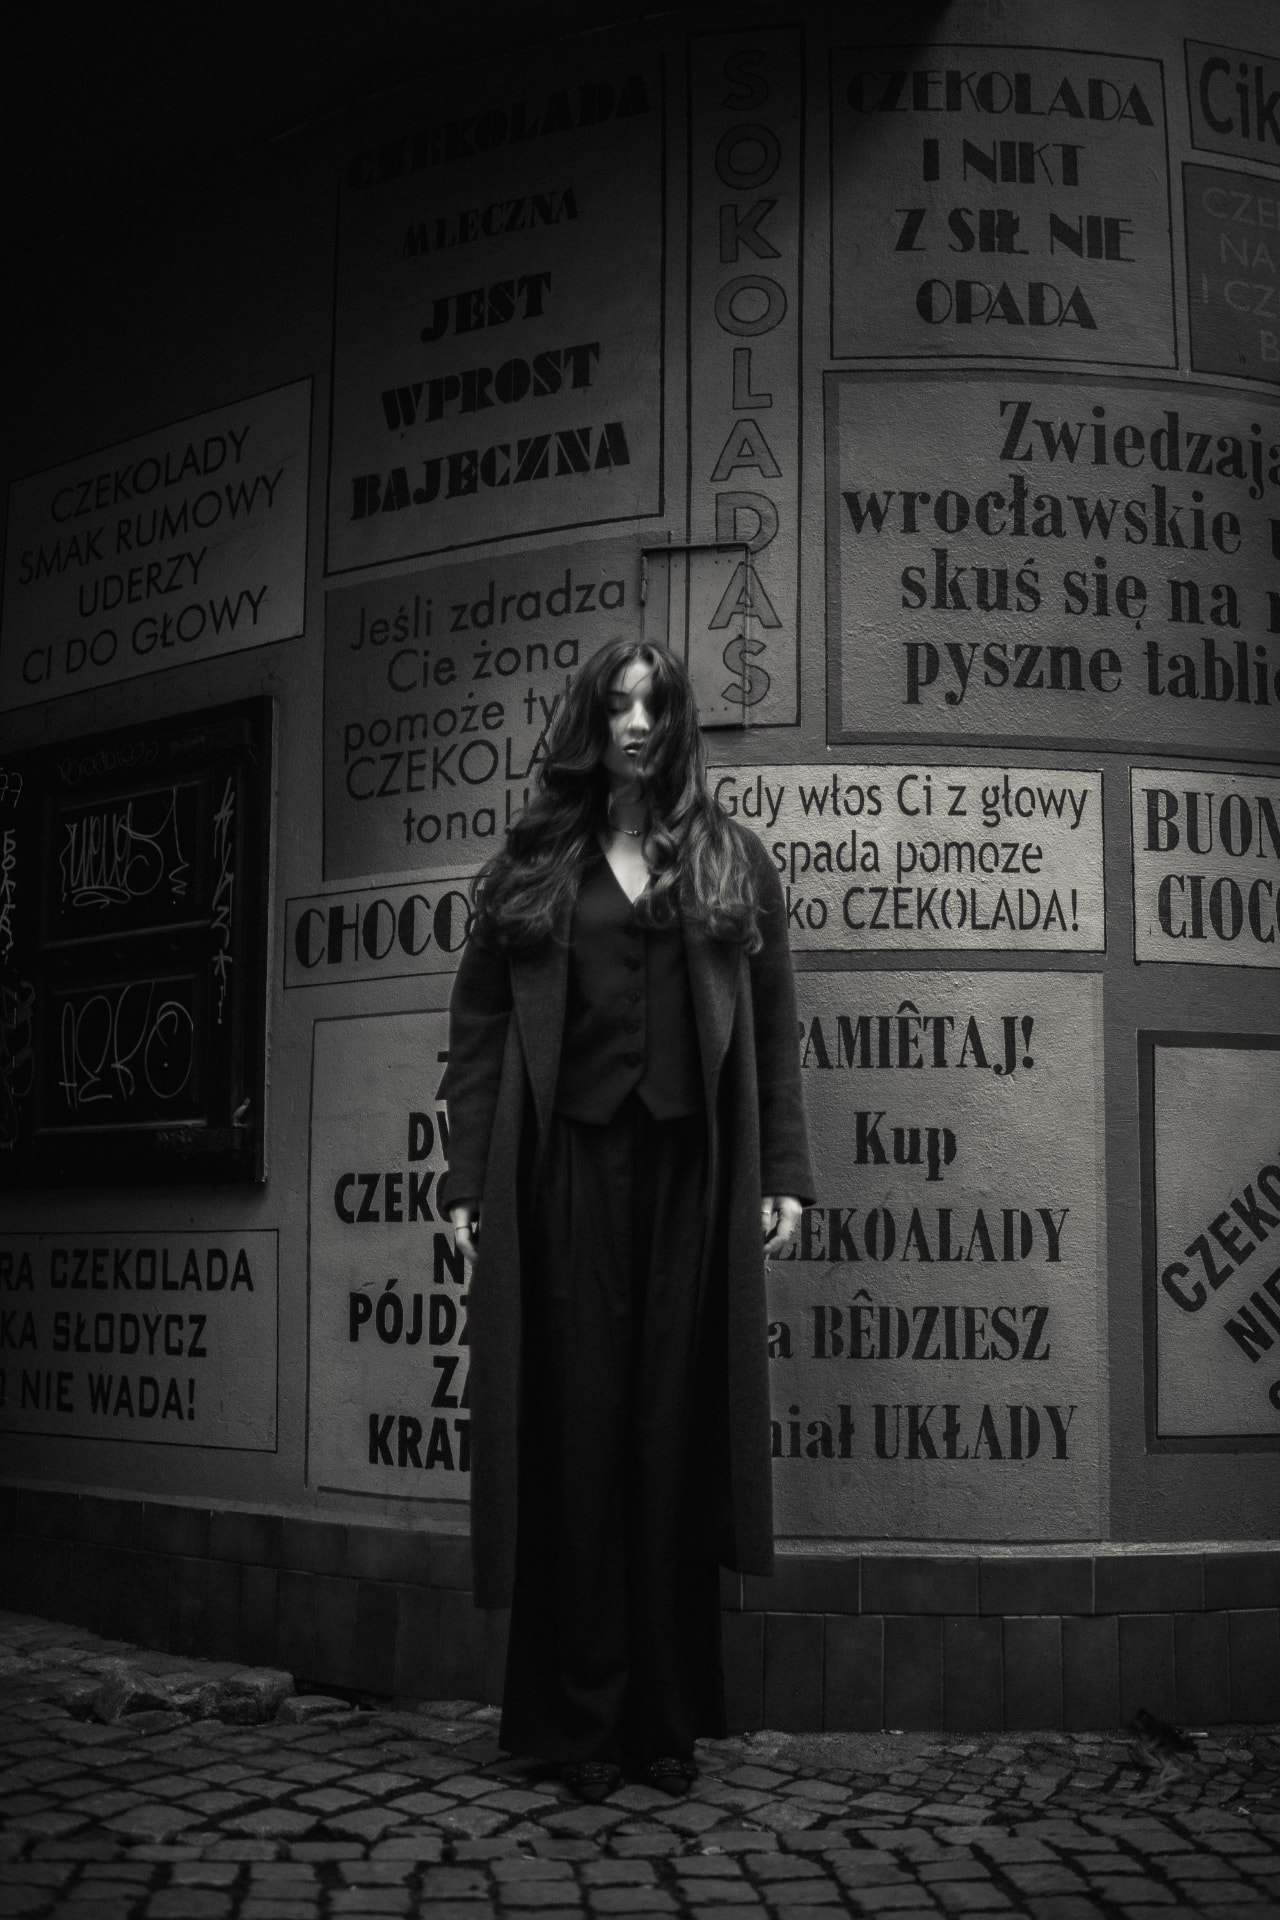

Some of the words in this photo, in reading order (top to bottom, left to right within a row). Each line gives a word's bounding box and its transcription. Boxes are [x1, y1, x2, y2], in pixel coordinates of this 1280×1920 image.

[846, 69, 1155, 127] CZEKOLADA
[922, 138, 940, 182] I
[962, 137, 1086, 186] NIKT
[401, 187, 580, 259] MLECZNA
[894, 208, 927, 252] Z
[947, 207, 1030, 255] SIŁ
[1049, 212, 1136, 262] NIE
[1202, 185, 1280, 228] CZE
[420, 272, 552, 343] JEST
[915, 278, 1098, 330] OPADA
[381, 342, 602, 431] WPROST
[709, 49, 788, 706] SOKOLADAS
[51, 425, 250, 523] CZEKOLADY
[350, 421, 630, 521] BAJECZNA
[19, 526, 104, 585] SMAK
[116, 467, 285, 554] RUMOWY
[842, 473, 1241, 555] wrocławskie
[78, 546, 208, 618] UDERZY
[352, 594, 433, 650] Jeśli
[450, 568, 625, 632] zdradza
[901, 548, 1041, 614] skuś
[1064, 556, 1148, 631] się
[1168, 578, 1241, 630] na
[22, 644, 54, 684] CI
[65, 629, 118, 675] DO
[131, 584, 269, 655] GŁOWY
[472, 639, 579, 680] żona
[902, 641, 1123, 706] pyszne
[1144, 637, 1280, 706] tabli
[344, 692, 504, 765] pomoże
[714, 775, 785, 828] Gdy
[799, 773, 882, 816] włos
[896, 775, 931, 817] Ci
[948, 785, 967, 816] z
[981, 774, 1088, 829] głowy
[772, 829, 880, 884] spada
[842, 886, 1079, 932] CZEKOLADA!
[853, 1110, 957, 1181] Kup
[50, 1249, 254, 1292] CZEKOLADA
[53, 1311, 208, 1358] SŁODYCZ
[21, 1369, 74, 1413] NIE
[88, 1372, 196, 1421] WADA!
[871, 1405, 1078, 1460] UKŁADY
